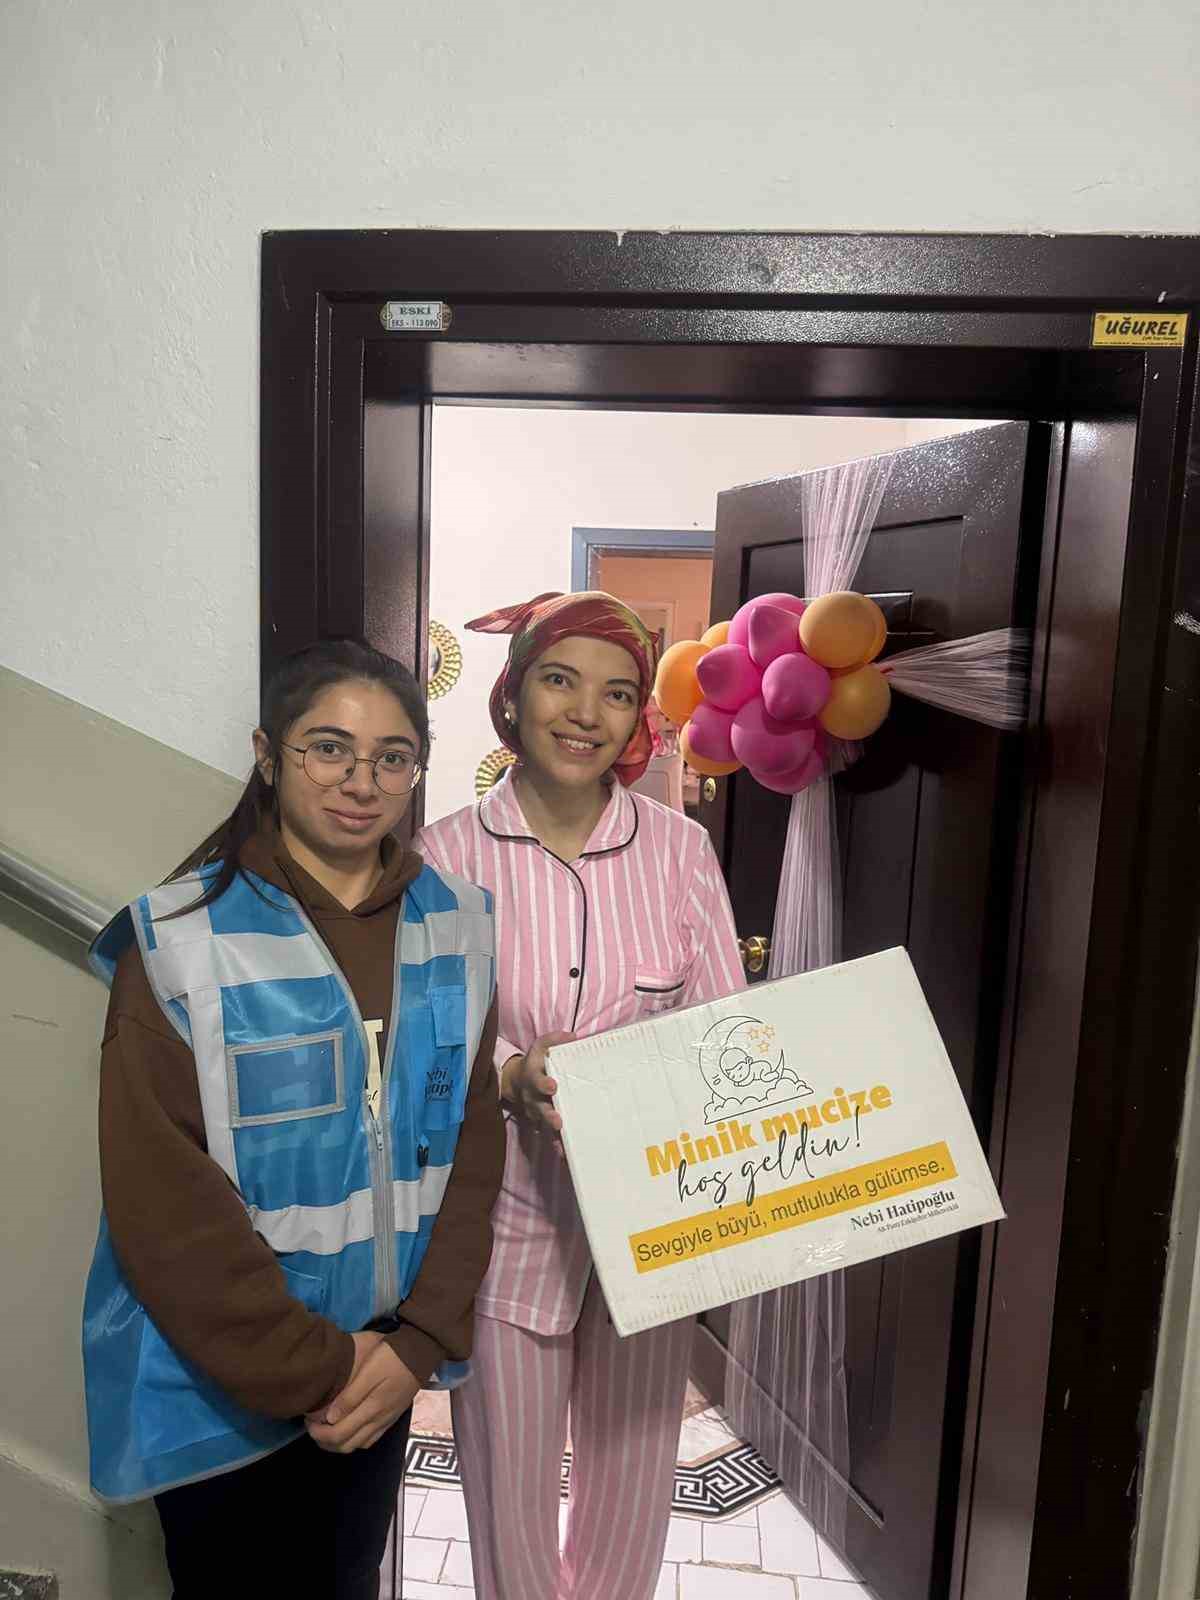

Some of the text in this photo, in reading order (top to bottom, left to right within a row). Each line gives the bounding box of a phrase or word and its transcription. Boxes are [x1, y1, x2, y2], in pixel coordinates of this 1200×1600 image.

[1105, 317, 1178, 335] UĞUREL
[646, 1084, 893, 1177] Minik mucize
[637, 1156, 946, 1264] Sevgiyle büyü, mutlulukla gülümse.
[677, 1159, 734, 1210] hoş
[850, 1189, 956, 1232] Nebi Hatipoğlu
